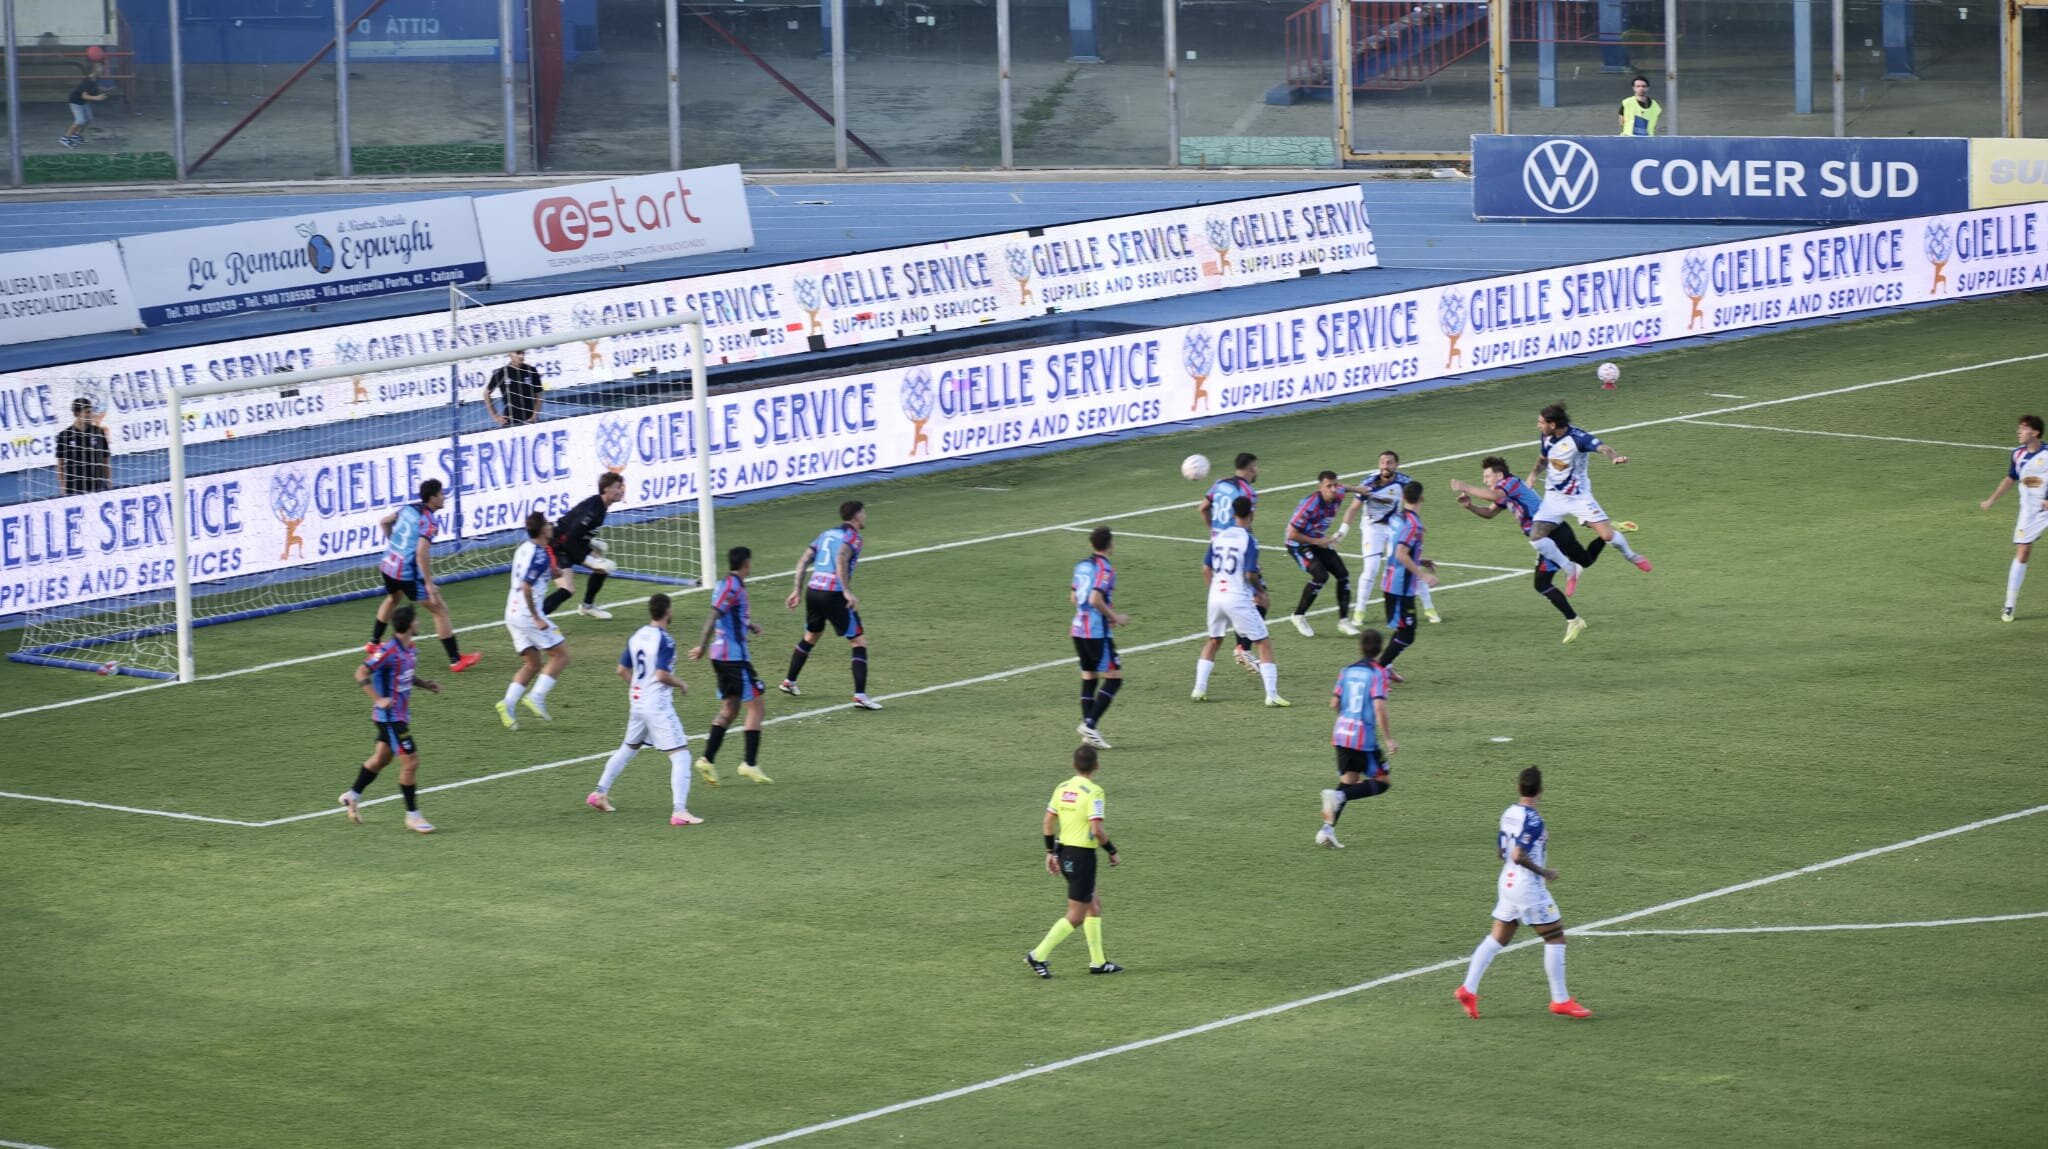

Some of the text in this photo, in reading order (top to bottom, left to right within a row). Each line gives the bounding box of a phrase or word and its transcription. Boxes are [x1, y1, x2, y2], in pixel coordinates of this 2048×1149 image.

[1630, 158, 1919, 198] COMER SUD
[537, 177, 702, 248] restart
[1231, 209, 1299, 251] GIELLE
[188, 257, 216, 291] La
[341, 220, 433, 269] Espurghi
[1032, 224, 1194, 278] GIELLE SERVICE
[1240, 252, 1295, 275] SUPPLIES
[1299, 248, 1326, 265] AND
[1957, 213, 2037, 262] GIELLE
[822, 252, 993, 309] GIELLE SERVICE
[1042, 266, 1198, 303] SUPPLIES AND SERVICES
[1712, 229, 1904, 296] GIELLE SERVICE
[1957, 266, 2026, 292] SUPPLIES
[901, 306, 930, 326] AND
[935, 296, 998, 319] SERVICES
[1470, 263, 1662, 334] GIELLE SERVICE
[1714, 282, 1903, 327] SUPPLIES AND SERVICES
[613, 343, 677, 367] SUPPLIES
[683, 338, 713, 358] AD
[1218, 300, 1418, 375] GIELLE SERVICE
[1472, 317, 1662, 366] SUPPLIES AND SERVICES
[379, 377, 447, 402] SUPPLIES
[939, 340, 1160, 418] GIELLE SERVICE
[1220, 357, 1418, 408] SUPPLIES AND SERVICES
[122, 395, 325, 442] SUPPLES AND SERVICES
[754, 383, 877, 448] SERVICE
[942, 399, 1160, 452] SUPPLIES AND SERVICES
[314, 430, 570, 518] GIELLE SERVICE
[640, 444, 877, 501] SUPPLES AND SERVICES
[1, 506, 84, 570] ELLE
[818, 536, 835, 566] 5
[1212, 546, 1239, 576] 55
[78, 566, 128, 597] AND
[636, 649, 647, 680] 6
